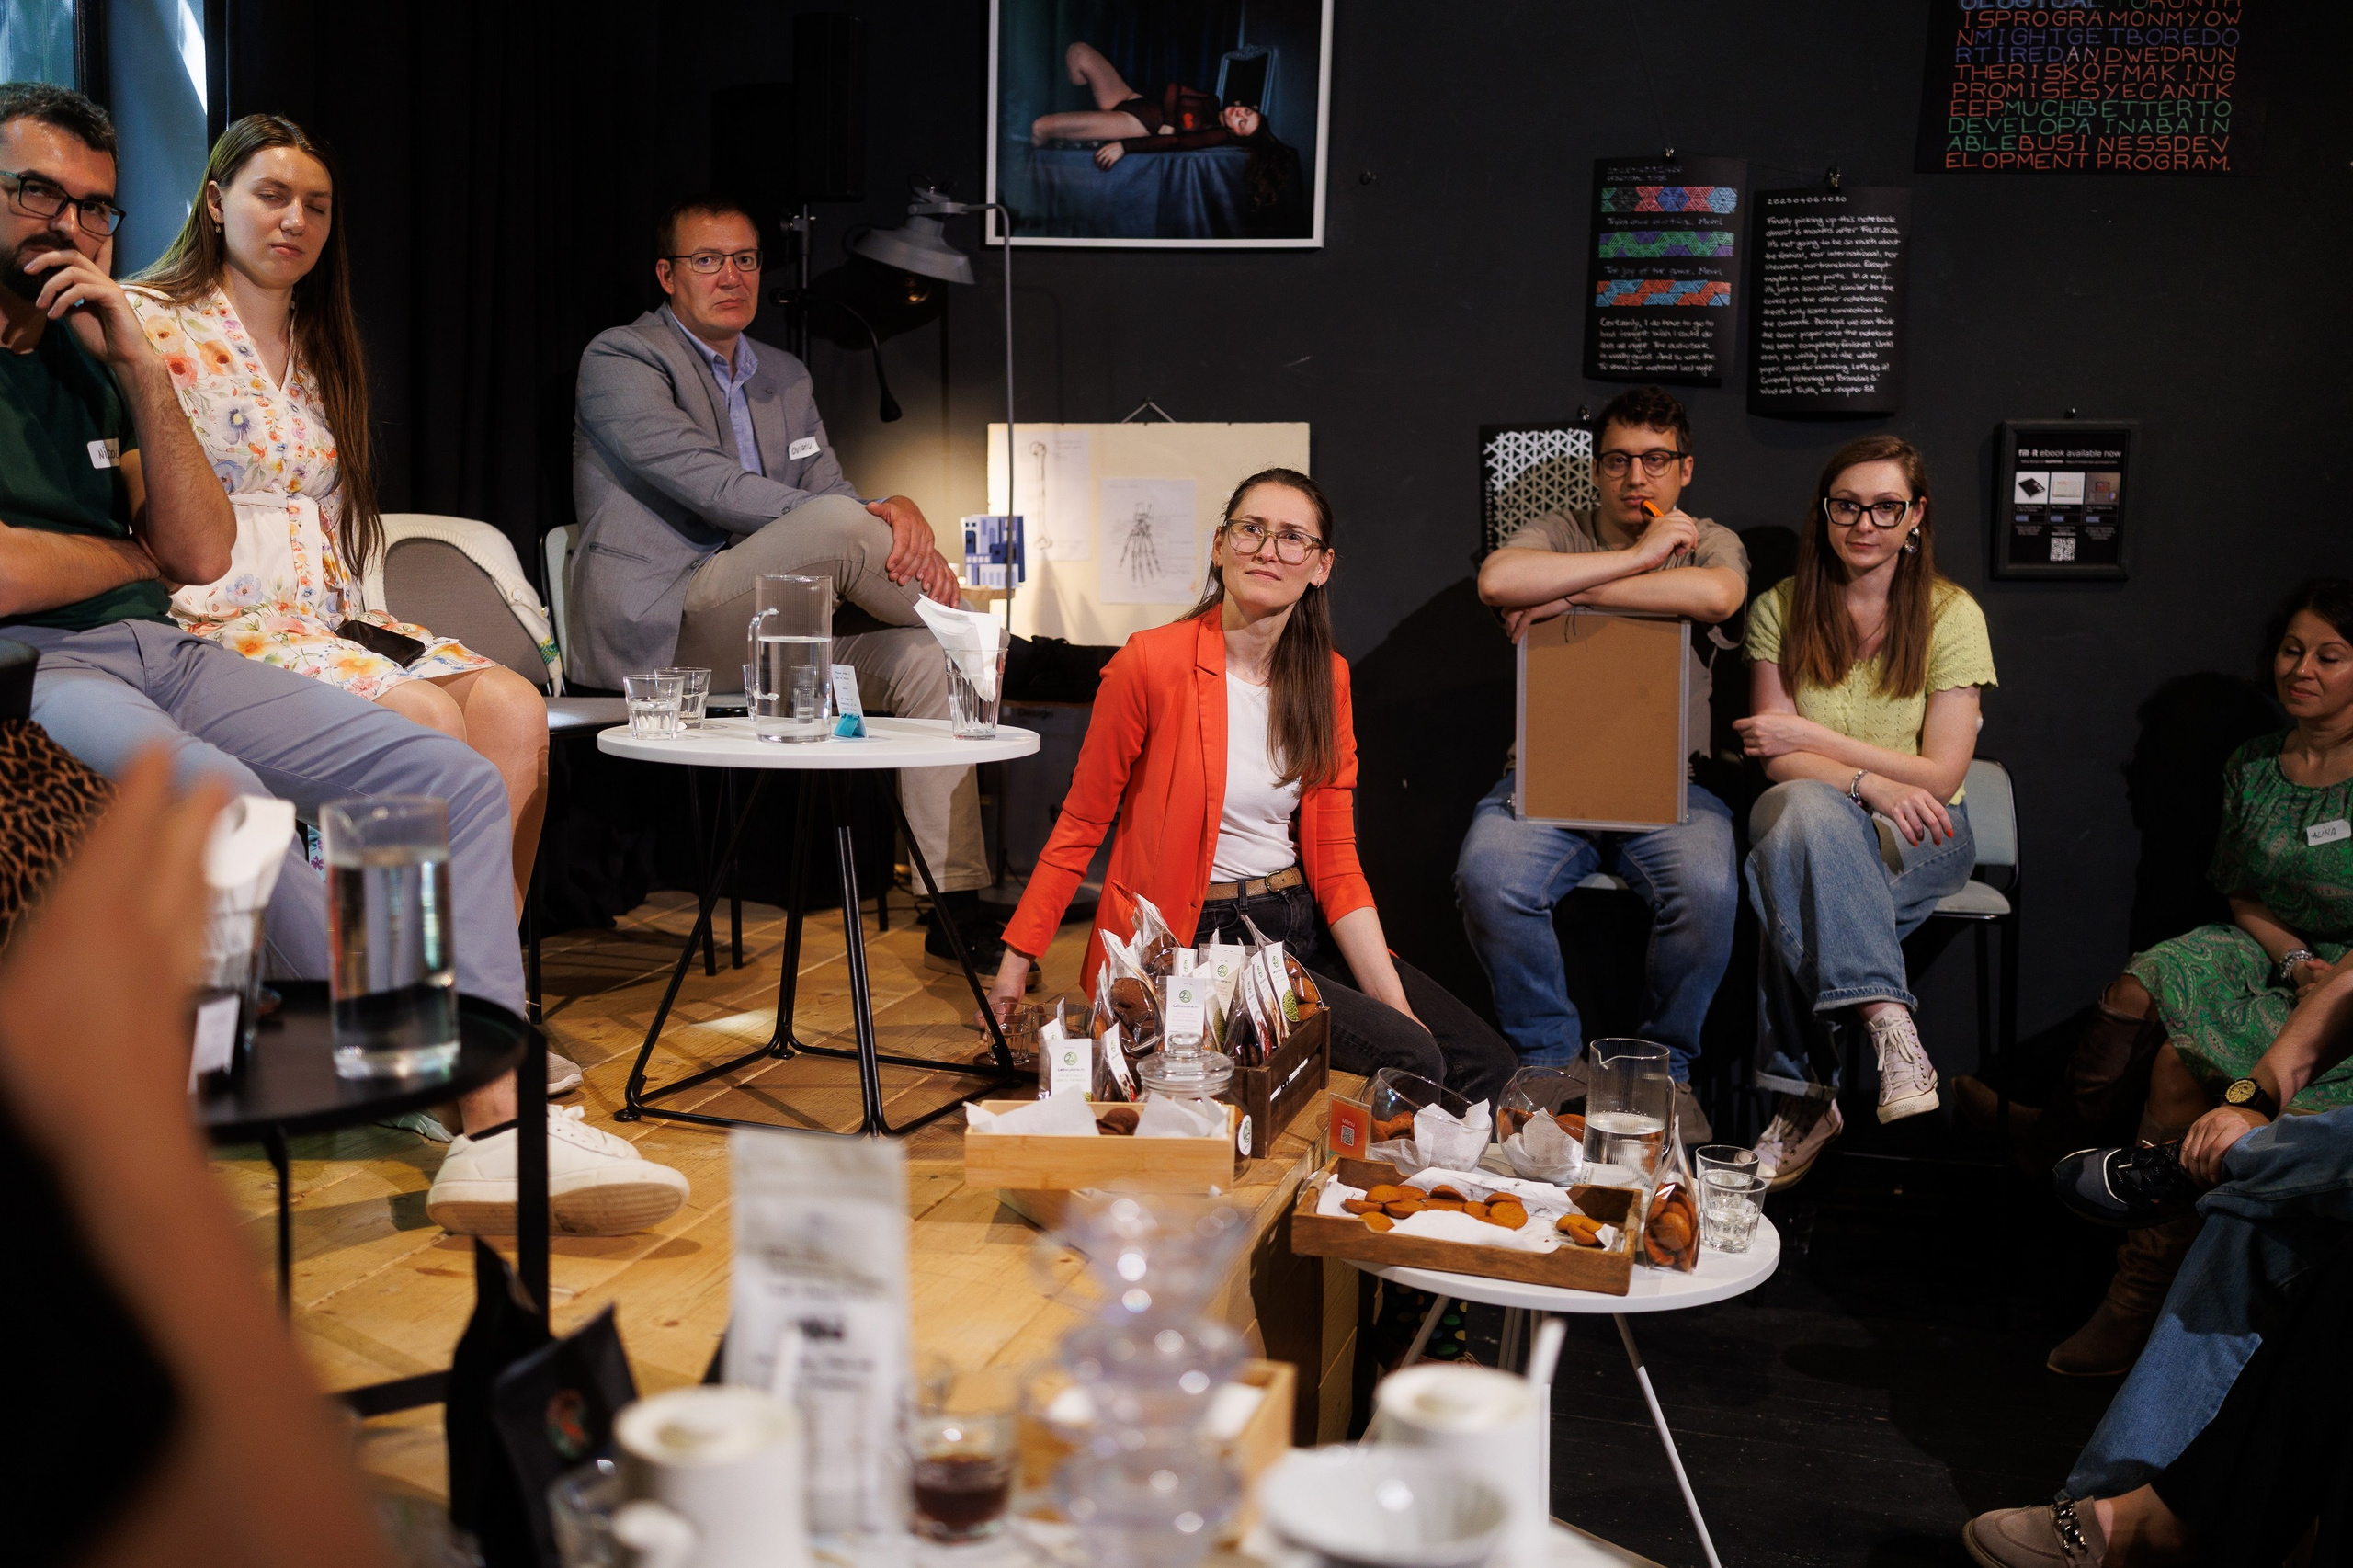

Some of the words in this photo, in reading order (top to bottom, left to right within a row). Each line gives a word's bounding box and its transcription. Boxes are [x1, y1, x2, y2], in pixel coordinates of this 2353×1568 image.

[2040, 449, 2064, 458] ebook
[2066, 449, 2102, 458] available
[1341, 1118, 1356, 1128] Menu
